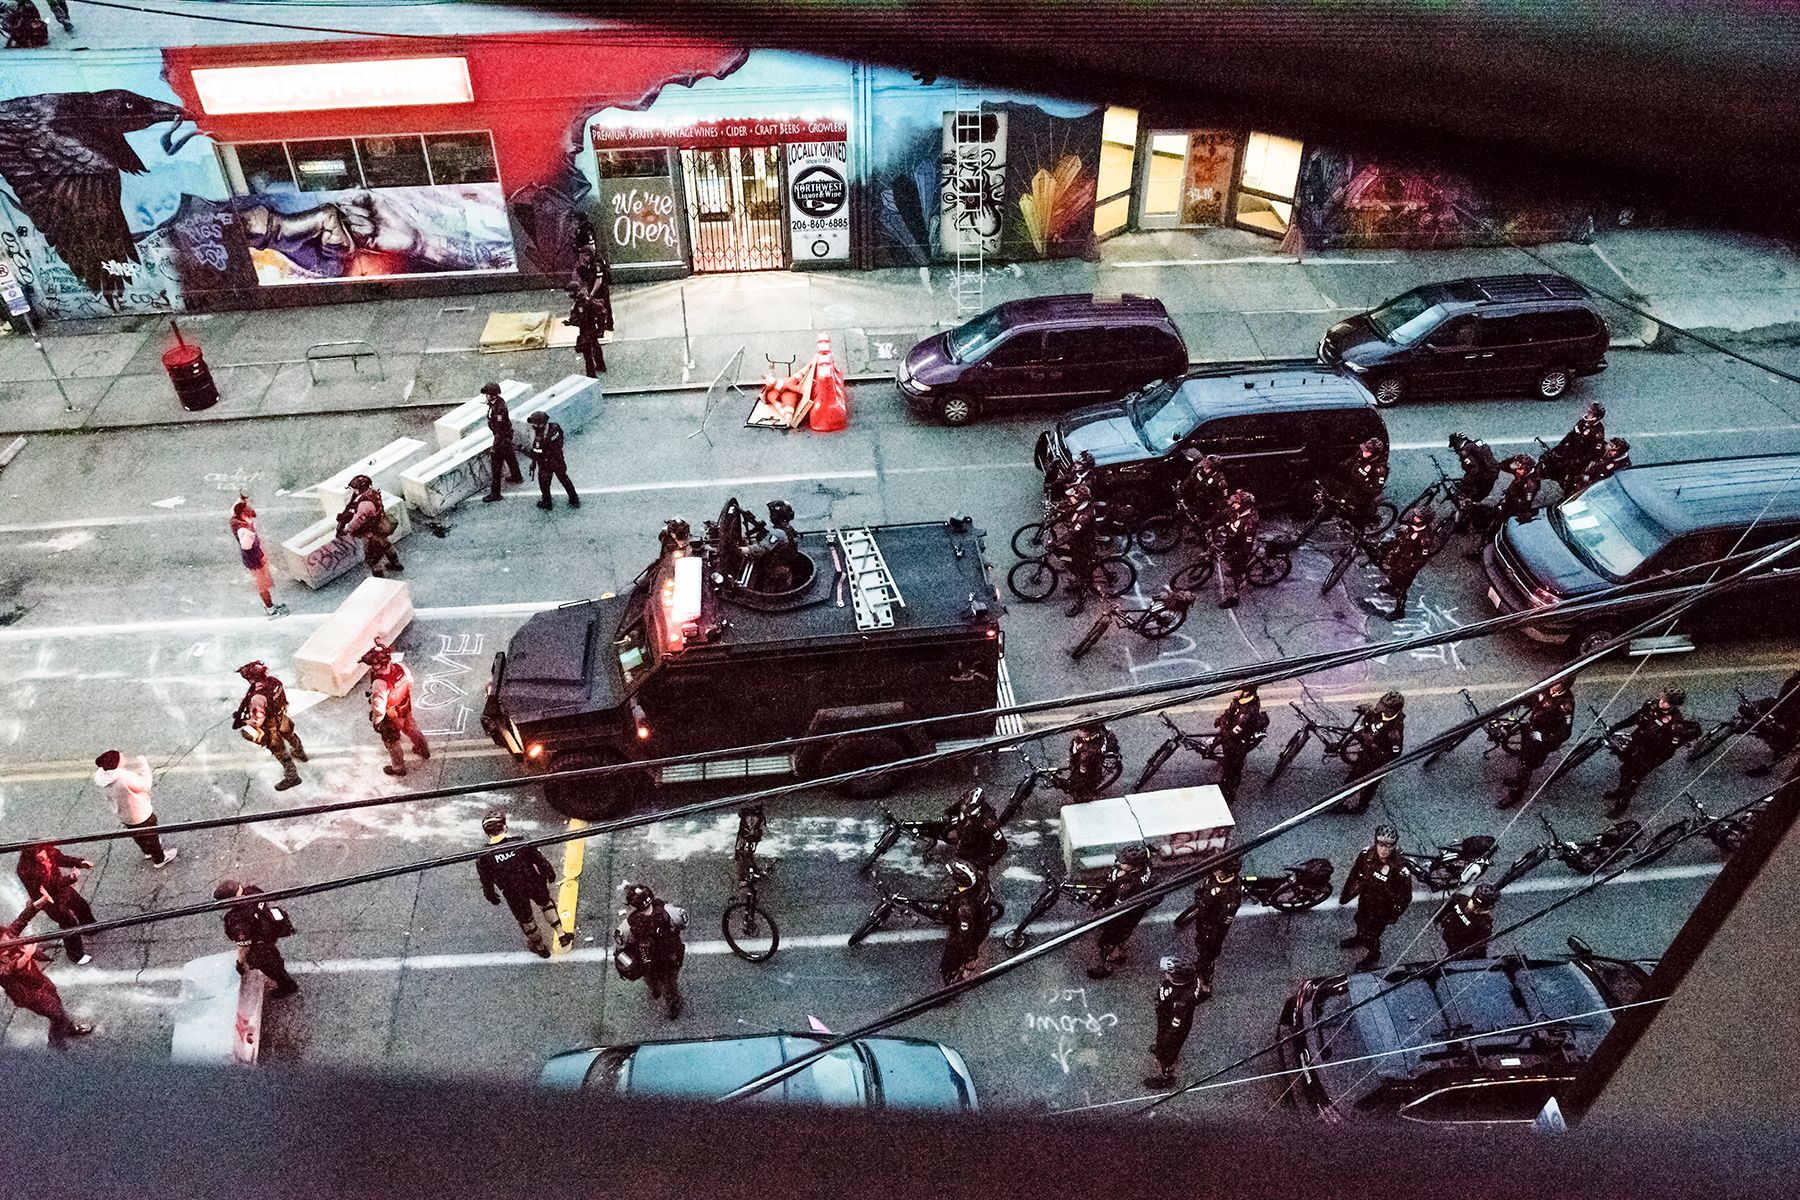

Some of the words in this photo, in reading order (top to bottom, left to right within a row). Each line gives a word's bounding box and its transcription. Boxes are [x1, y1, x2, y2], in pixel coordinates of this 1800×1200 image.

[592, 129, 627, 141] PREMIUM
[628, 127, 654, 140] SPIRITS
[662, 127, 694, 139] VINTAGE
[694, 126, 718, 138] WINES
[725, 125, 748, 137] CIDER
[754, 123, 779, 136] CRAFT
[780, 123, 800, 135] BEERS
[808, 121, 846, 134] GROWLERS
[788, 143, 819, 166] LOCALLY
[820, 142, 847, 163] OWNED
[793, 181, 843, 194] NORTHWEST
[825, 190, 842, 198] Wine
[611, 188, 674, 215] We're
[613, 215, 679, 249] Open!
[791, 218, 848, 230] 206-860-6885
